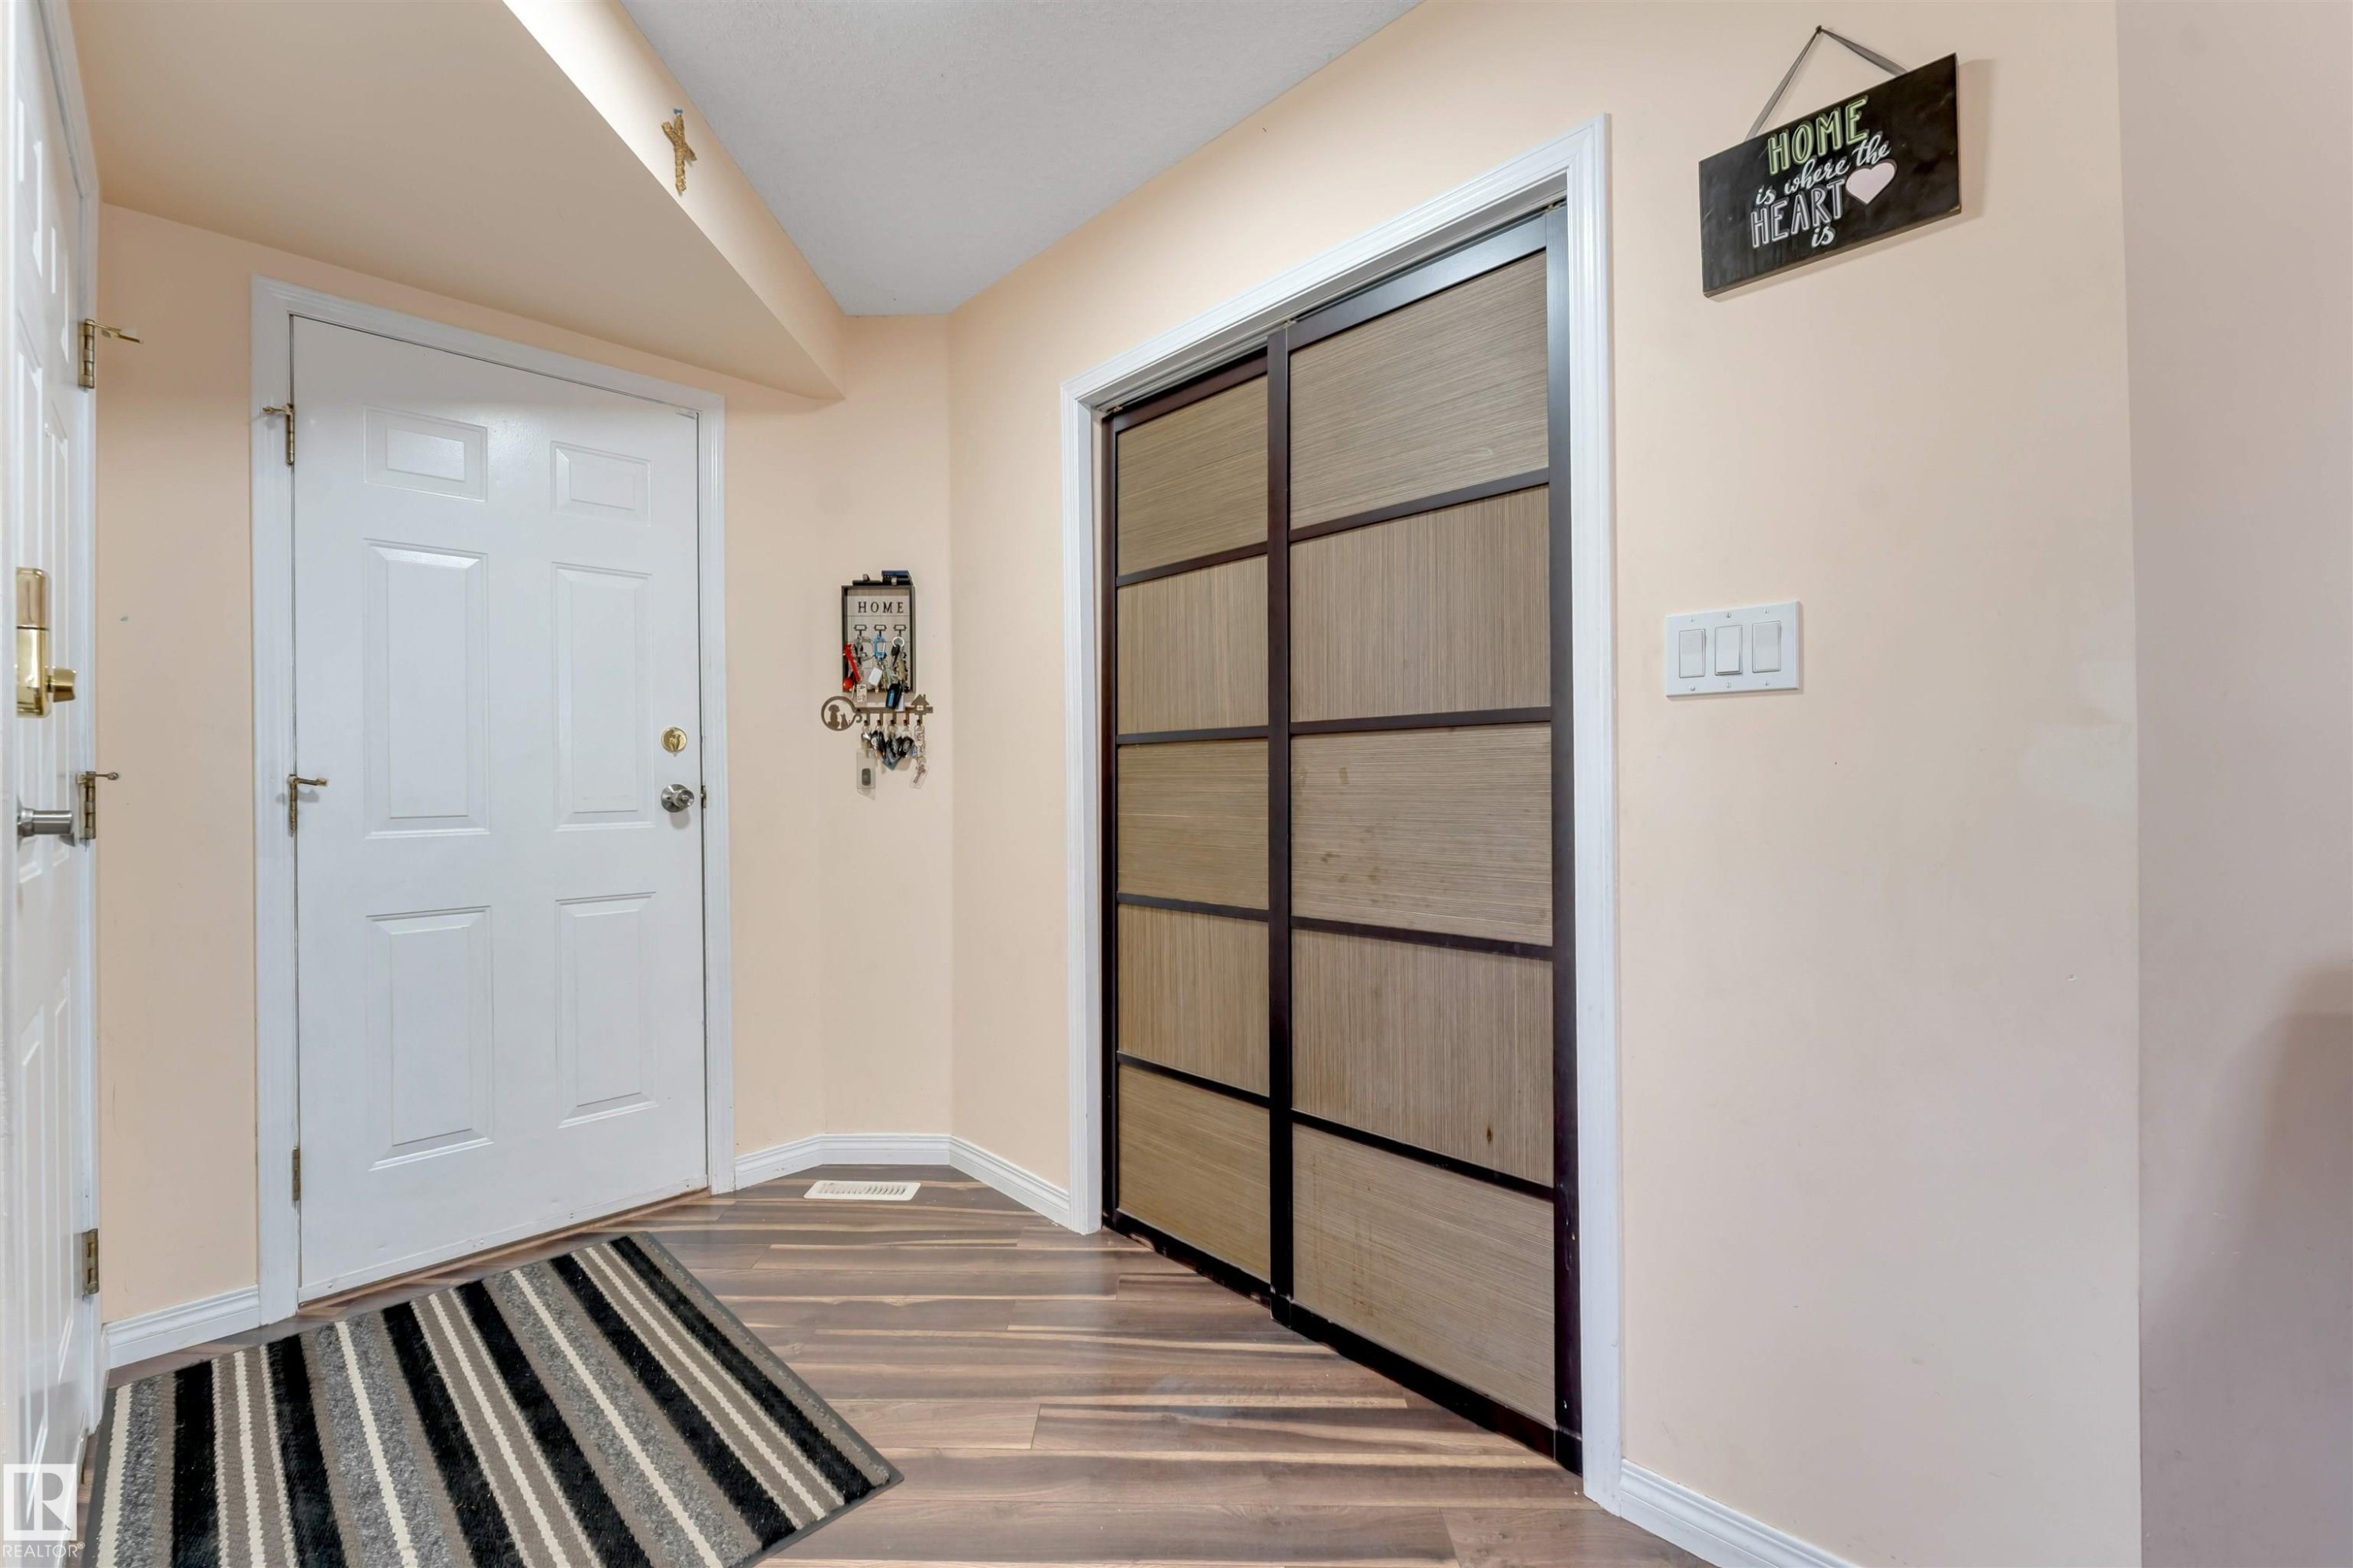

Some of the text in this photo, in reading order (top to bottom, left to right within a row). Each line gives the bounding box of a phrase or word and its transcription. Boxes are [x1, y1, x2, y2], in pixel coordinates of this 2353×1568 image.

[1755, 131, 1891, 206] is where the
[1768, 96, 1868, 174] HOME
[1751, 178, 1846, 248] HEART
[1811, 224, 1835, 248] is
[857, 602, 904, 613] HOME
